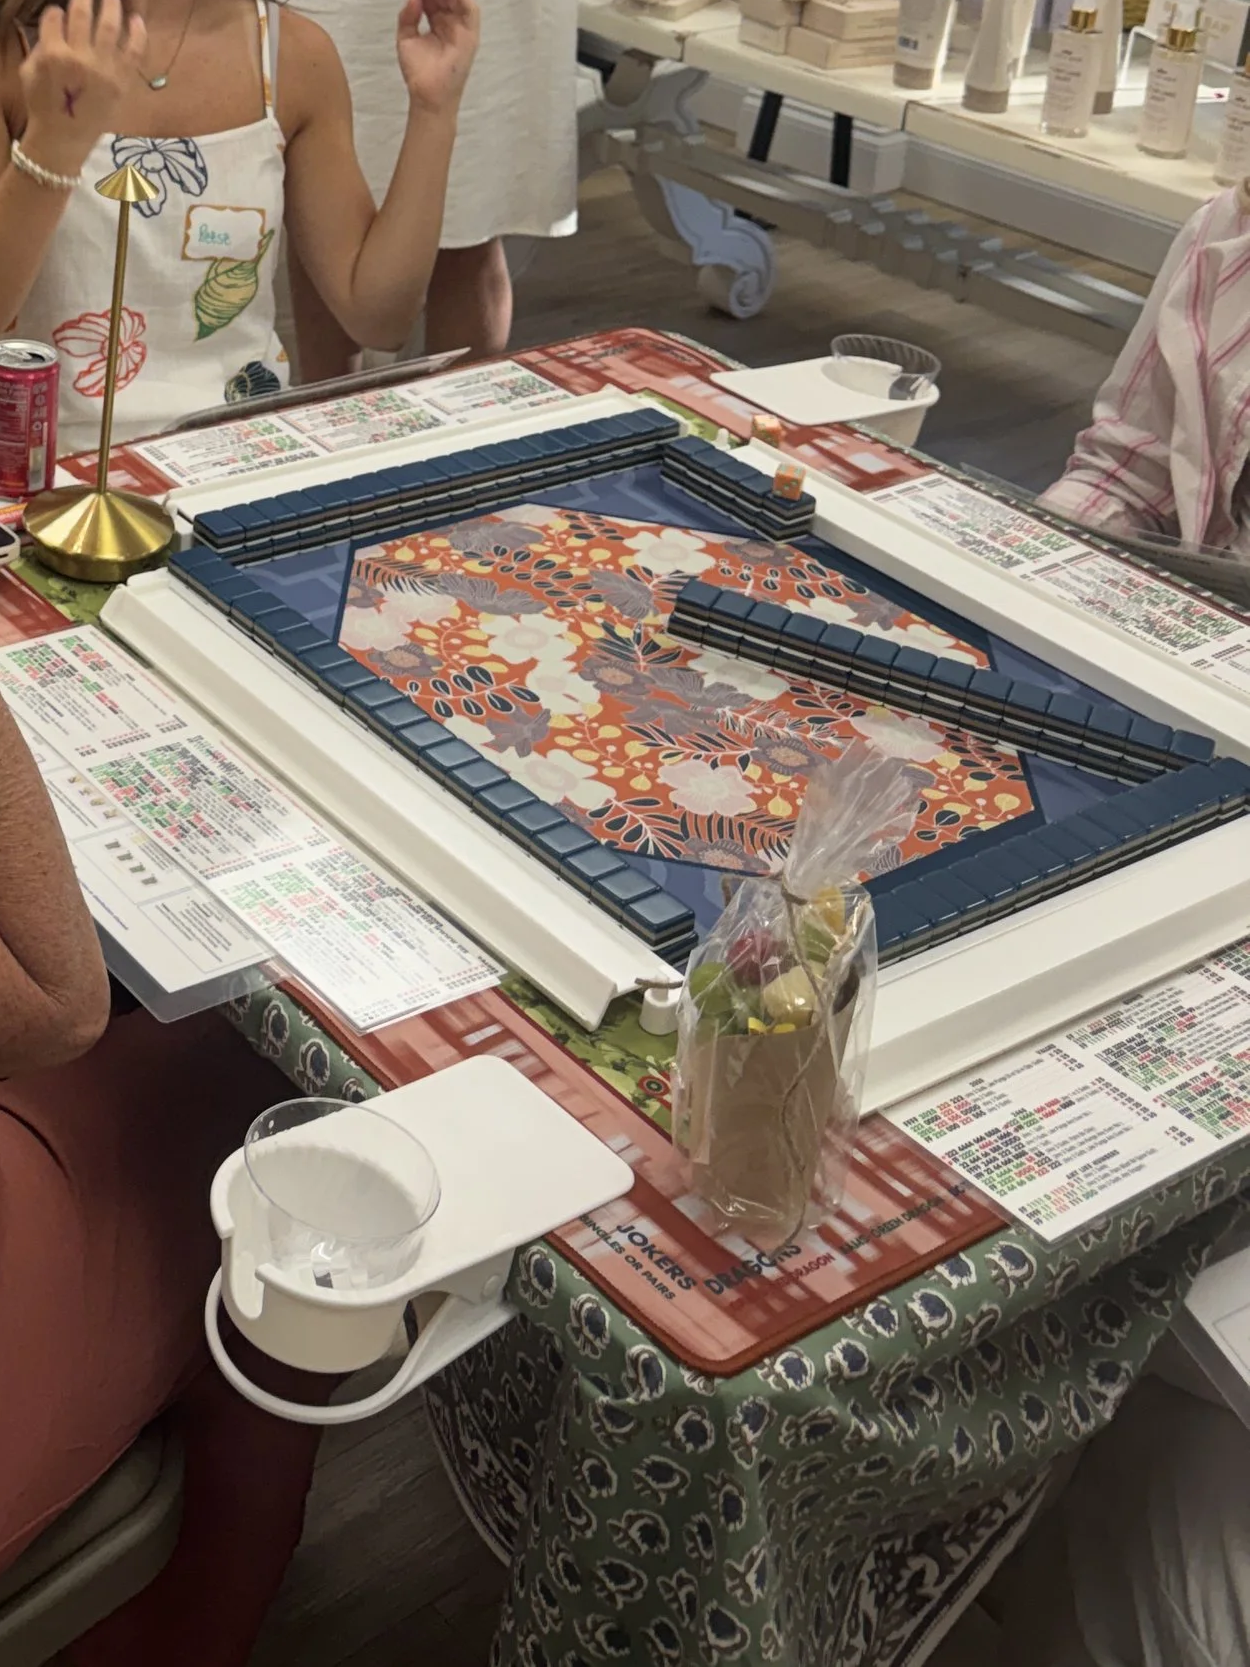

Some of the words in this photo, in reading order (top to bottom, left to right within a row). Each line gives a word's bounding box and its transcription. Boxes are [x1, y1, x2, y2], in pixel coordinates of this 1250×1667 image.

[616, 1224, 698, 1291] JOKERS
[624, 1254, 644, 1272] OR
[641, 1270, 677, 1301] PAIRS
[703, 1244, 802, 1296] DRAGONS
